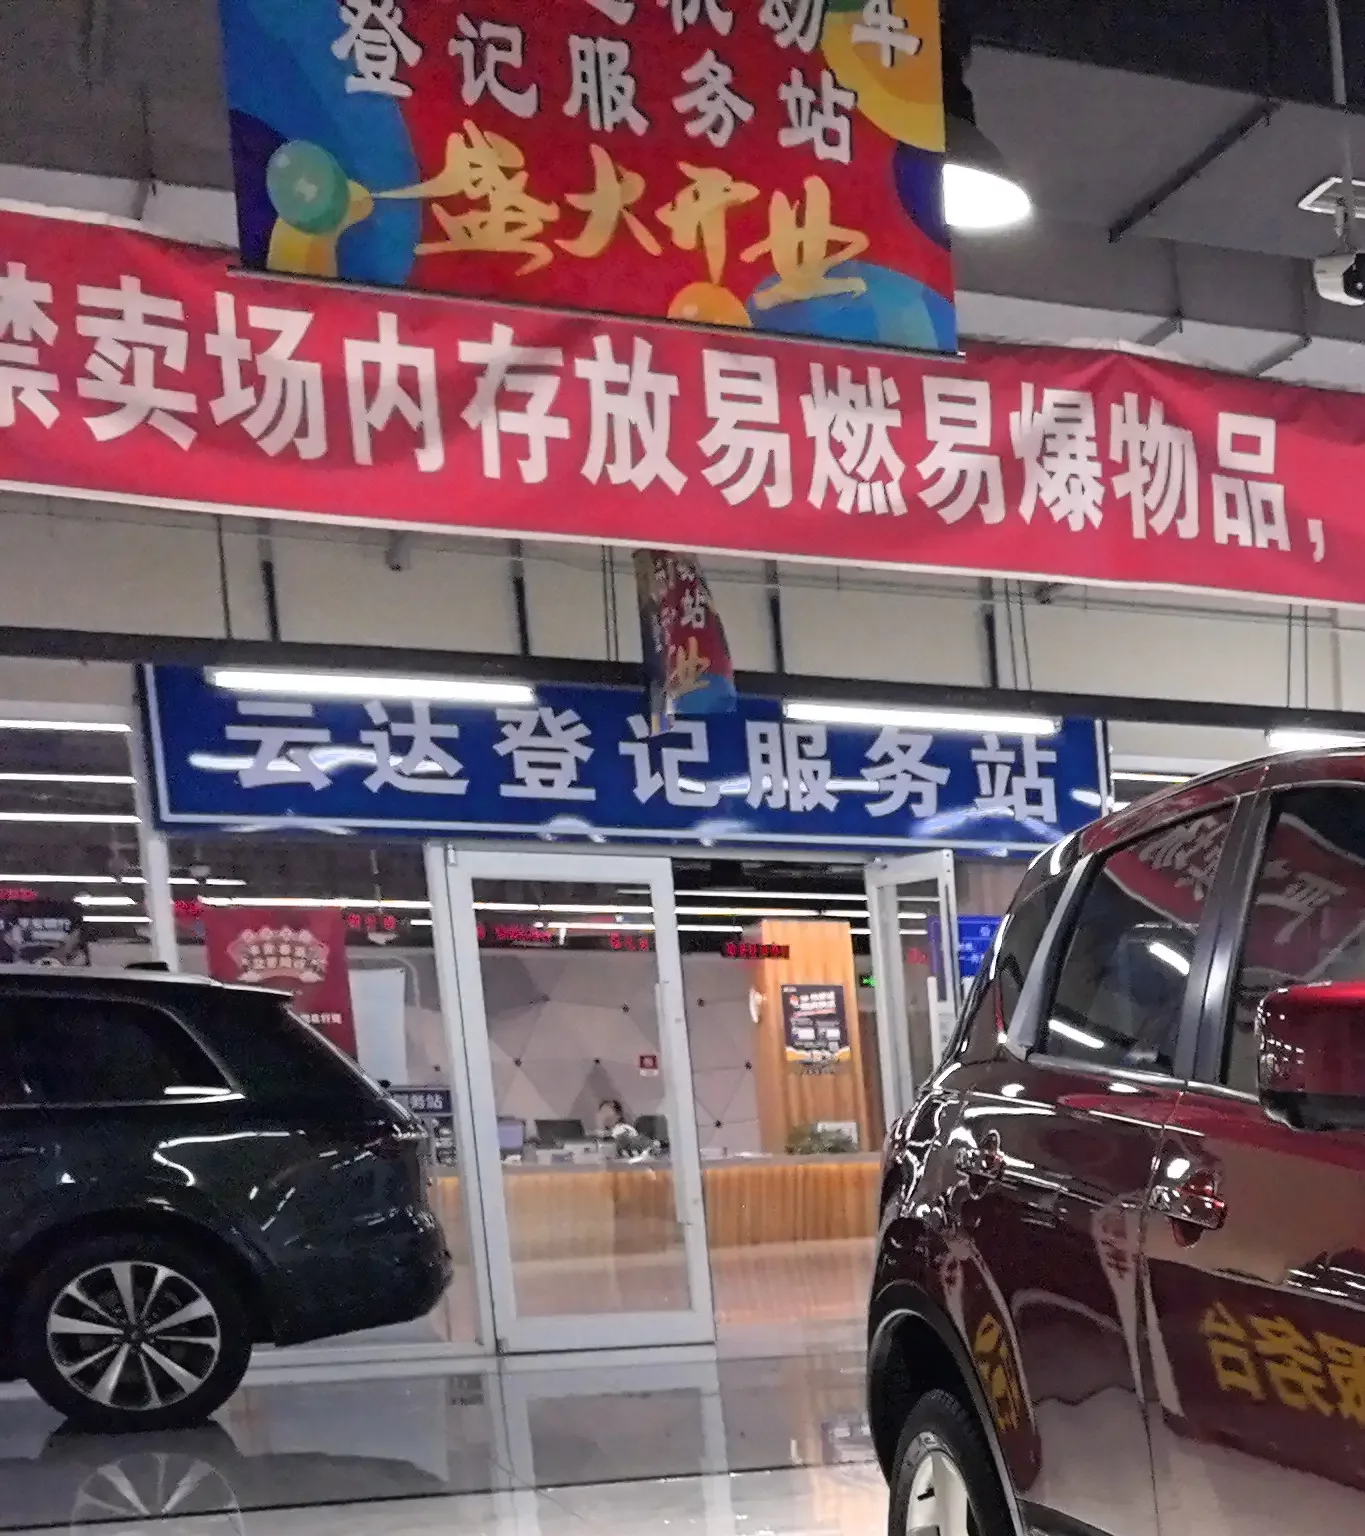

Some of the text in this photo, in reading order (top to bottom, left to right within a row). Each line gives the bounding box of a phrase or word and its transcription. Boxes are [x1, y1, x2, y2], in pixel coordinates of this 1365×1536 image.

[331, 0, 857, 165] 登记服务站
[374, 118, 869, 309] 盛大开业
[225, 698, 1059, 825] 云达登记服务站
